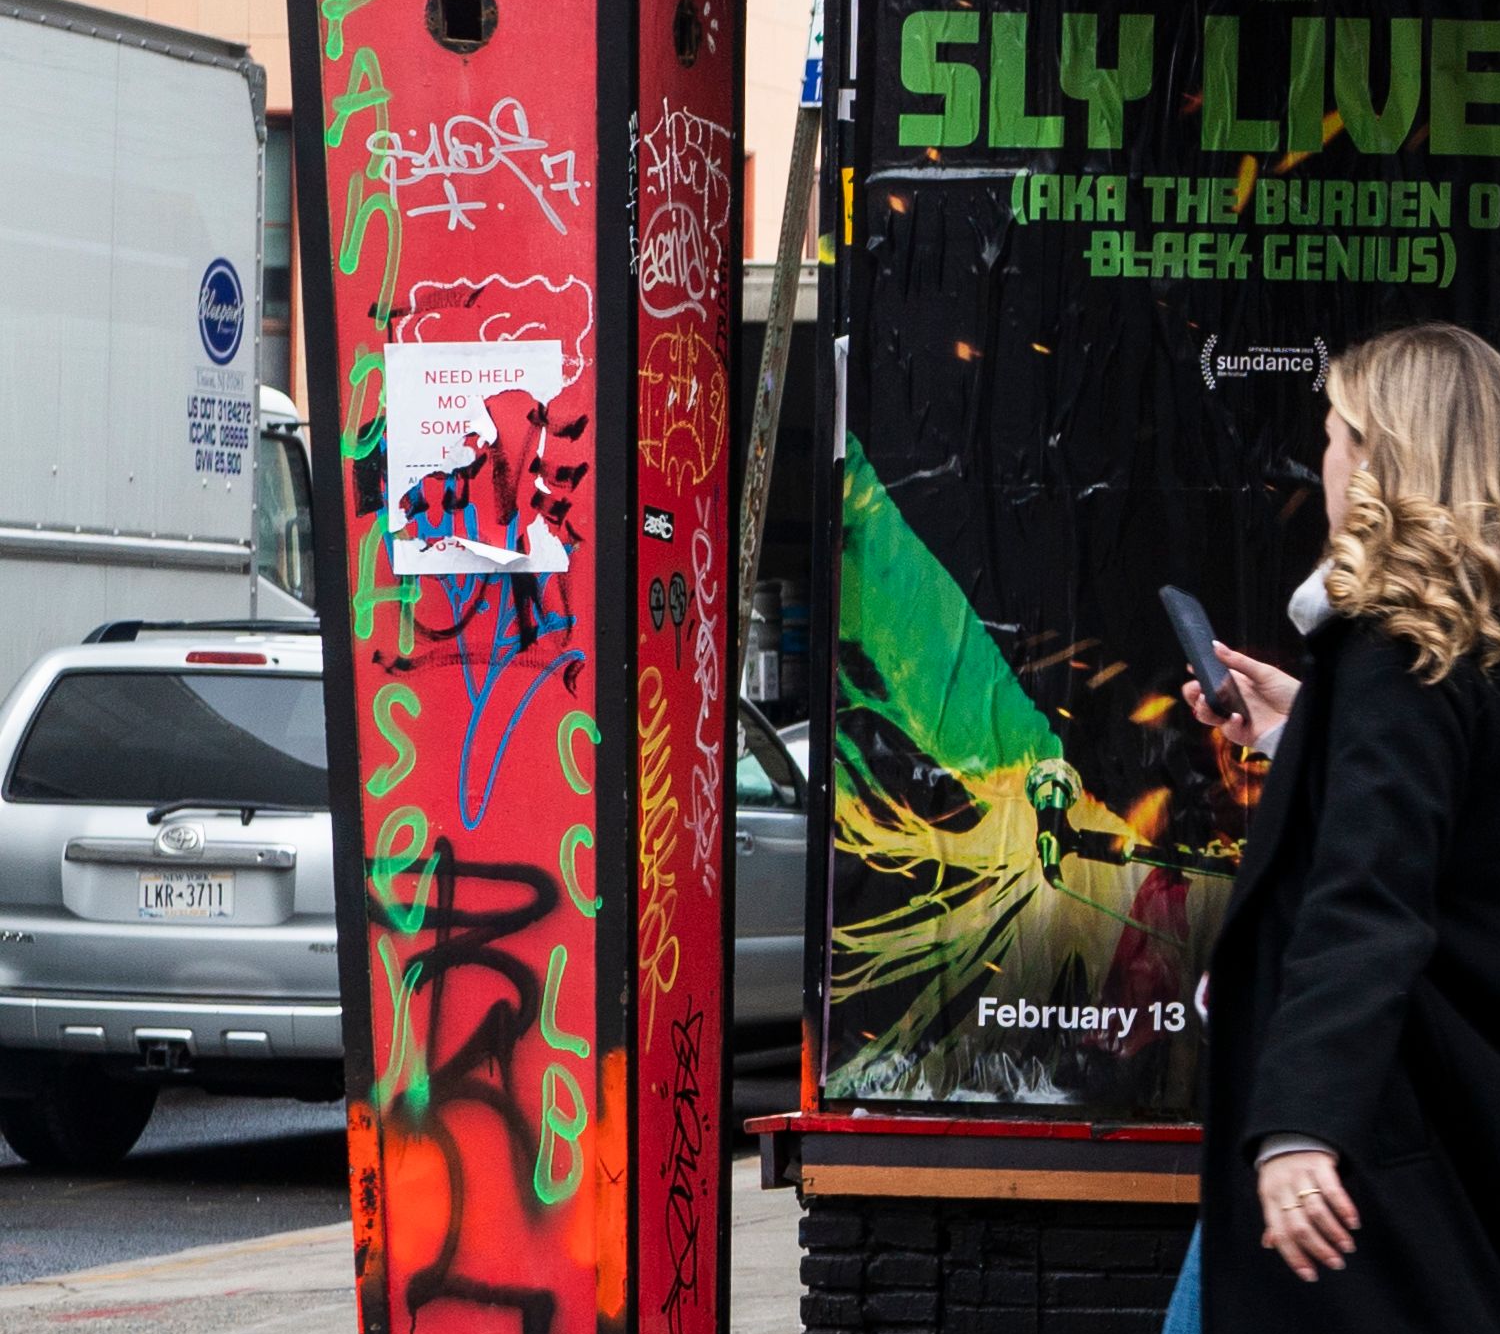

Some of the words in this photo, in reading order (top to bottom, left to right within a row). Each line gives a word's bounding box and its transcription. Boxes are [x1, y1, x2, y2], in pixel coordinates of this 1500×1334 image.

[898, 10, 1155, 151] SLY
[1011, 167, 1128, 226] (AKA
[1143, 176, 1239, 226] THE
[1256, 177, 1452, 228] BURDEN
[1085, 230, 1253, 280] BLACK
[1263, 231, 1457, 289] GENIUS)
[424, 369, 473, 385] NEED
[478, 368, 525, 383] HELP
[1216, 354, 1314, 372] sundance
[200, 397, 216, 420] DOT
[978, 997, 1138, 1038] February
[1148, 1001, 1186, 1032] 13
